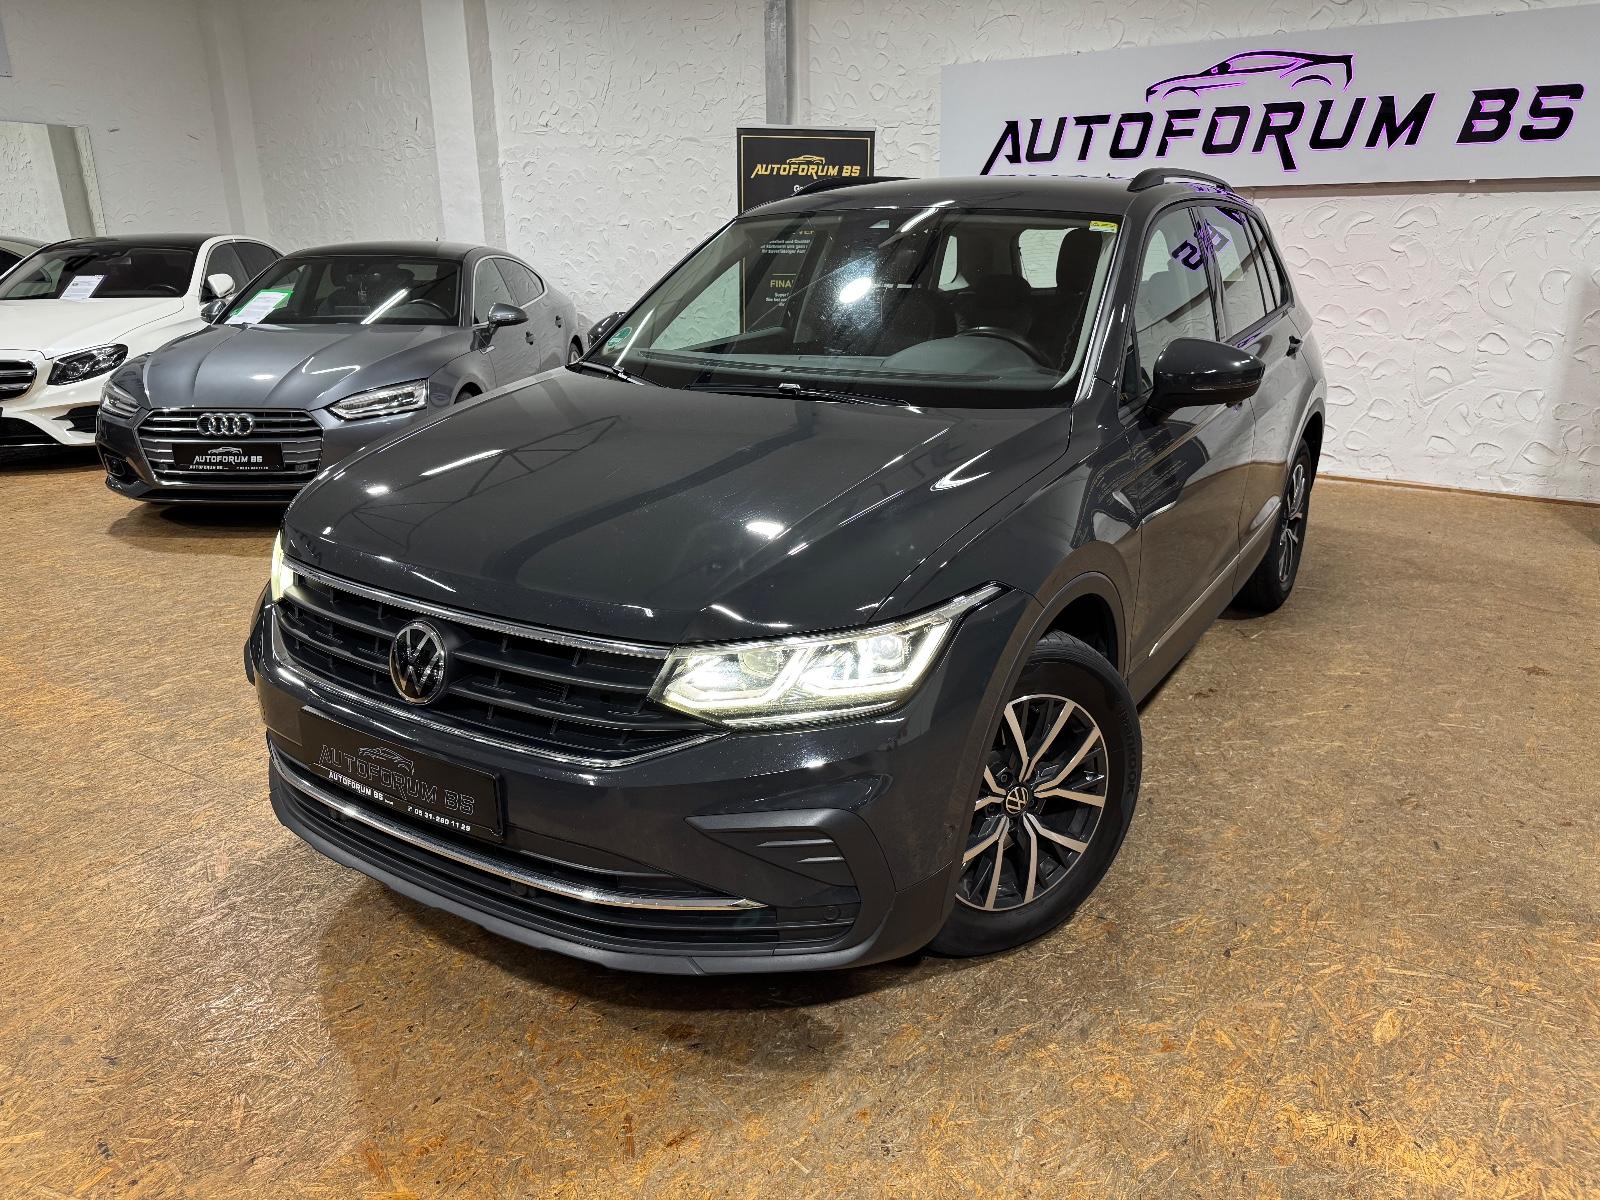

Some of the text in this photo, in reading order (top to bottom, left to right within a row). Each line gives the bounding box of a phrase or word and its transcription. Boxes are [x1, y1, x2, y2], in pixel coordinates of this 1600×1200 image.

[980, 83, 1585, 175] AUTOFORUM BS
[750, 163, 861, 180] AUTOFORUM BS
[770, 279, 794, 288] FINA
[193, 455, 248, 465] AUTOFORUM
[318, 744, 475, 815] AUTOFORUM BS
[328, 771, 372, 796] AUTOFORUM
